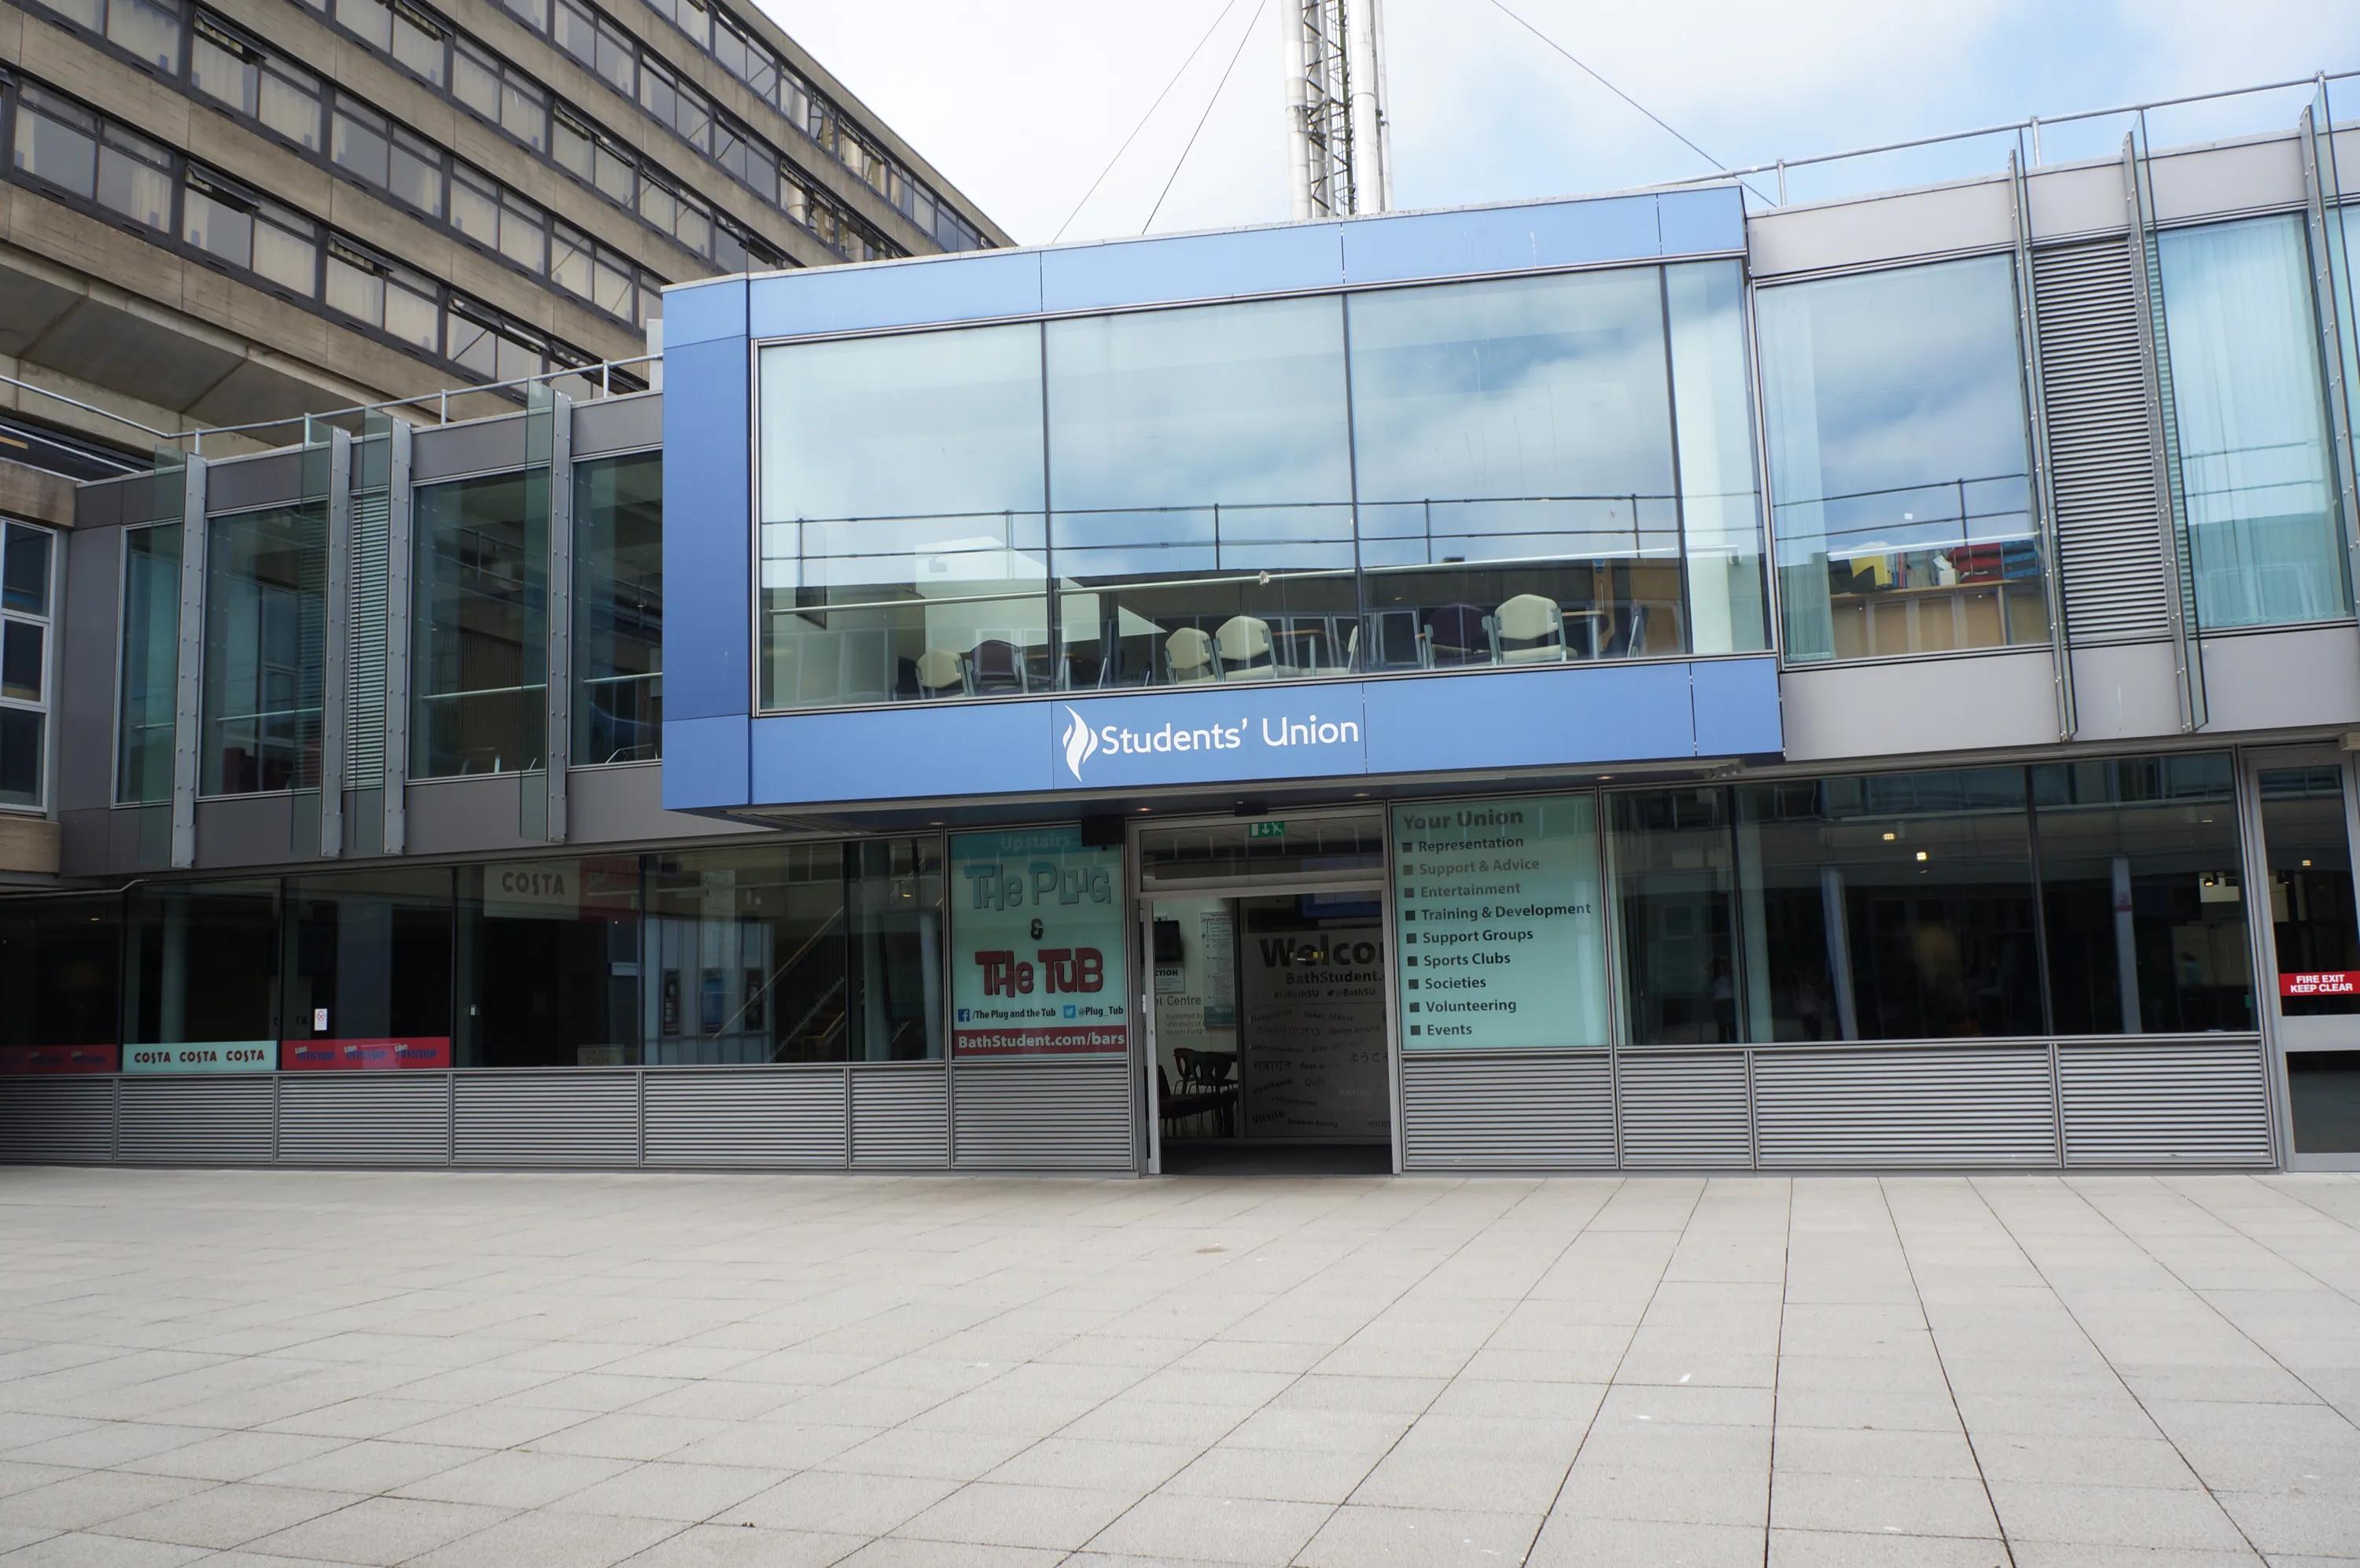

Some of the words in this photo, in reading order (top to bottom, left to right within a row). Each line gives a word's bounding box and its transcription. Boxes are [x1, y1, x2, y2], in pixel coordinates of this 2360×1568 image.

[1262, 714, 1359, 747] Union
[1403, 813, 1451, 831] Your
[1456, 808, 1524, 828] Union
[1000, 834, 1071, 852] Upstairs
[1418, 836, 1525, 855] Representation
[1419, 861, 1476, 878] Support
[1479, 860, 1490, 873] &
[1493, 858, 1541, 872] Advice
[501, 870, 565, 896] COSTA
[1420, 882, 1522, 899] Entertainment
[1421, 907, 1478, 922] Training
[1482, 906, 1493, 919] &
[1496, 903, 1592, 920] Development
[1423, 931, 1480, 947] Support
[1482, 928, 1534, 944] Groups
[1258, 934, 1385, 969] Welco
[1423, 954, 1469, 970] Sports
[1471, 951, 1511, 966] Clubs
[1424, 977, 1487, 990] Societies
[2296, 974, 2321, 984] FIRE
[2321, 974, 2346, 984] EXIT
[2289, 984, 2318, 994] KEEP
[2318, 982, 2354, 993] CLEAR
[1167, 995, 1202, 1007] Centre
[1425, 999, 1518, 1014] Volunteering
[972, 1010, 989, 1020] /The
[990, 1010, 1009, 1021] Plug
[1010, 1008, 1025, 1019] and
[1026, 1007, 1040, 1018] the
[1041, 1007, 1056, 1018] Tub
[1077, 1005, 1124, 1018] @Plug_Tub
[1427, 1023, 1474, 1036] Events
[957, 1032, 1126, 1049] BathStudent.com/bars
[134, 1051, 171, 1064] COSTA
[179, 1050, 217, 1064] COSTA
[226, 1049, 265, 1063] COSTA
